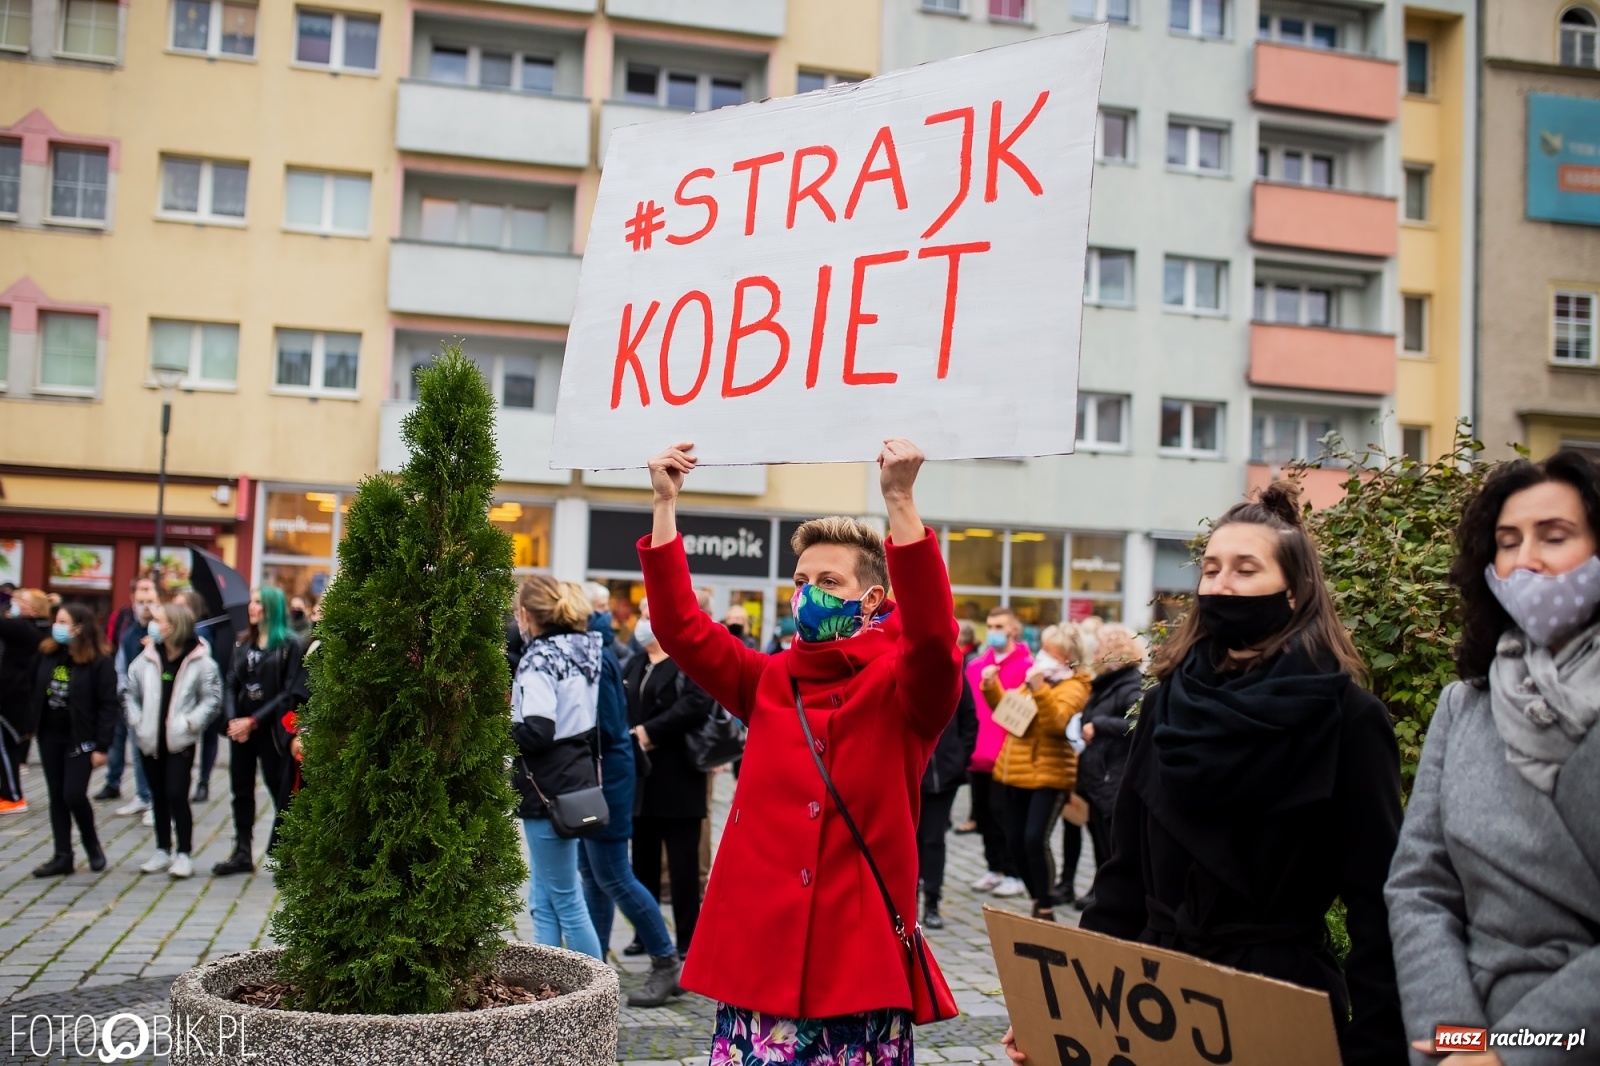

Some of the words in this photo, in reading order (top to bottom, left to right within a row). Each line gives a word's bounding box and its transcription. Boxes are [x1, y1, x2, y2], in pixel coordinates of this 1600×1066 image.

[625, 90, 1049, 252] #STRAJK
[610, 241, 991, 410] KOBIET
[682, 527, 764, 561] empik
[1013, 941, 1233, 1065] TWÓJ
